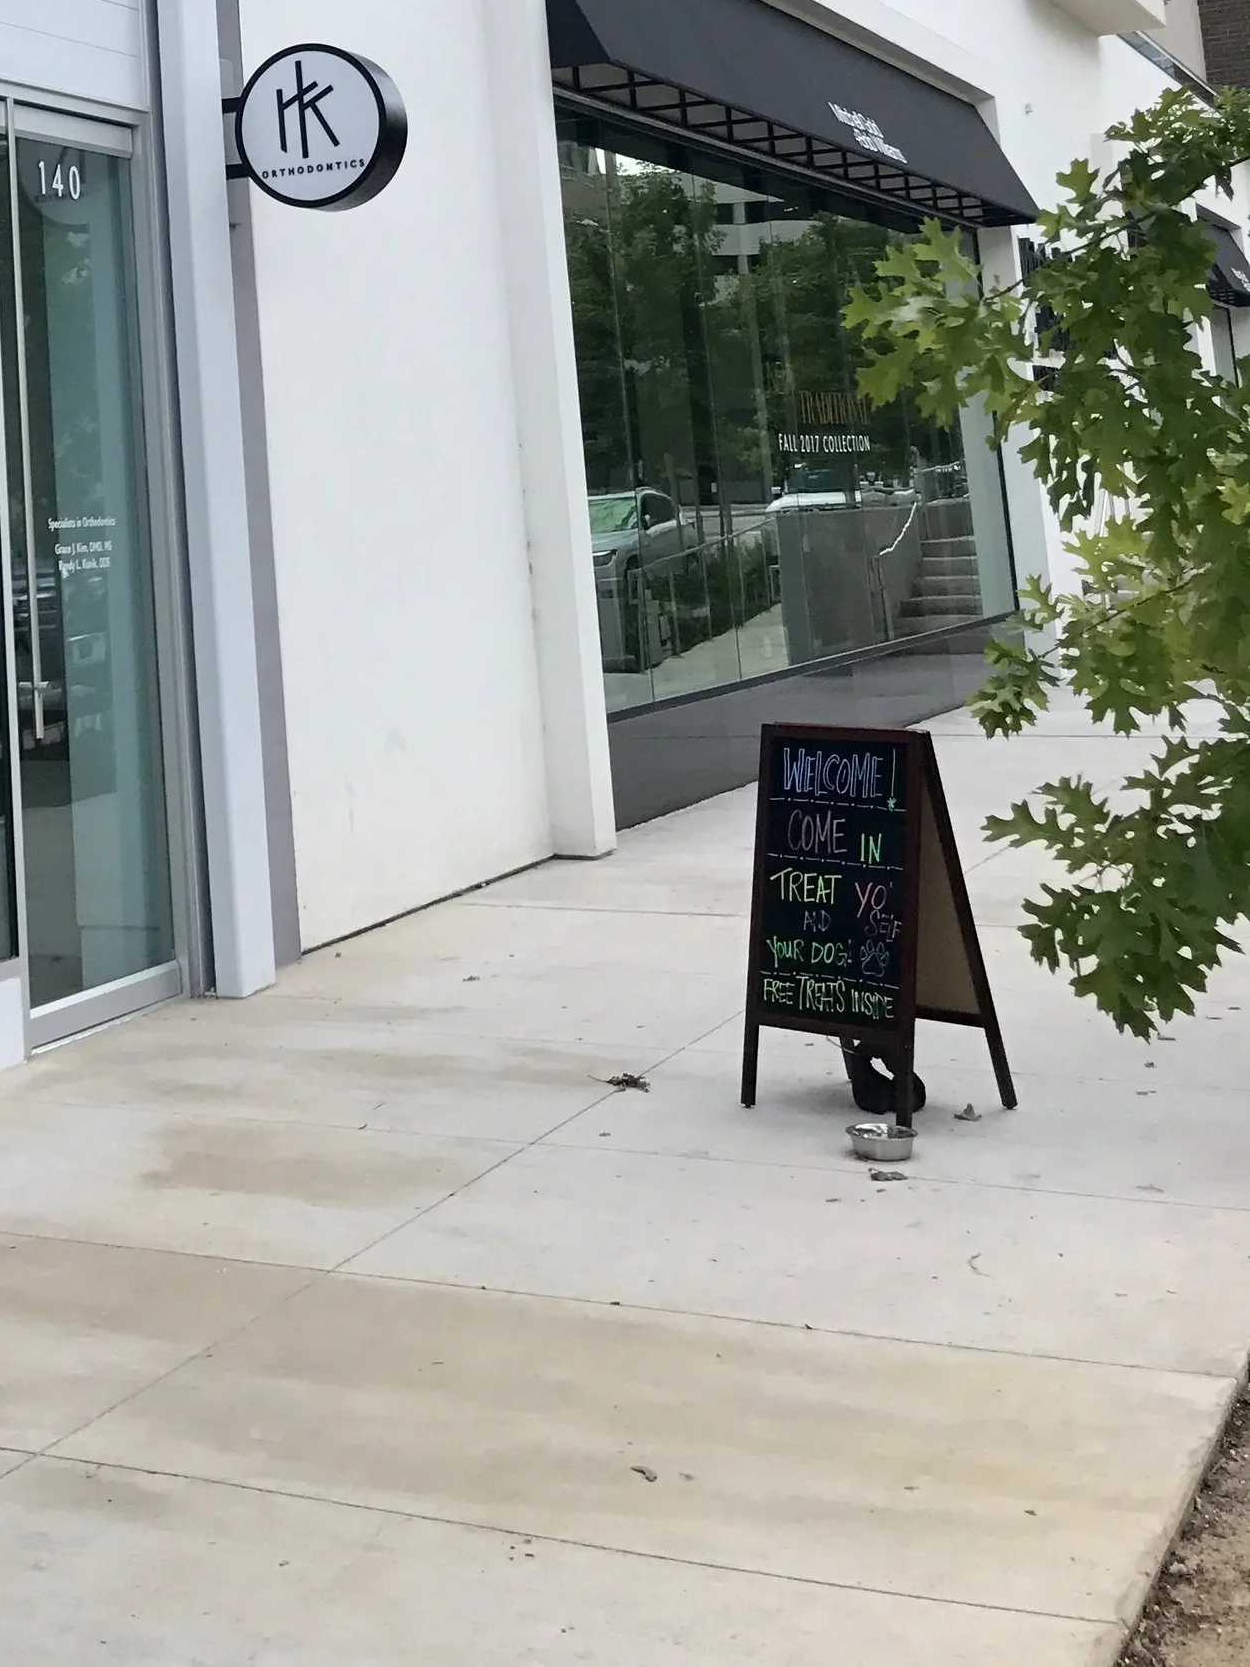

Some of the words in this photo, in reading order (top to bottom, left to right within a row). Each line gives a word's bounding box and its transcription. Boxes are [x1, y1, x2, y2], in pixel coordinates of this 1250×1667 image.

[38, 160, 80, 200] 140
[261, 158, 366, 180] ORTHODONTICS
[778, 433, 798, 452] FALL
[799, 434, 820, 453] 2017
[822, 434, 871, 453] COLLECTION
[787, 809, 847, 854] COME
[860, 833, 882, 864] IN
[769, 867, 843, 905] TREAT
[803, 909, 832, 933] AND
[766, 935, 804, 968] YOUR
[763, 978, 795, 1005] FREE
[795, 975, 846, 1013] TREATS
[851, 988, 895, 1020] INSIDE
